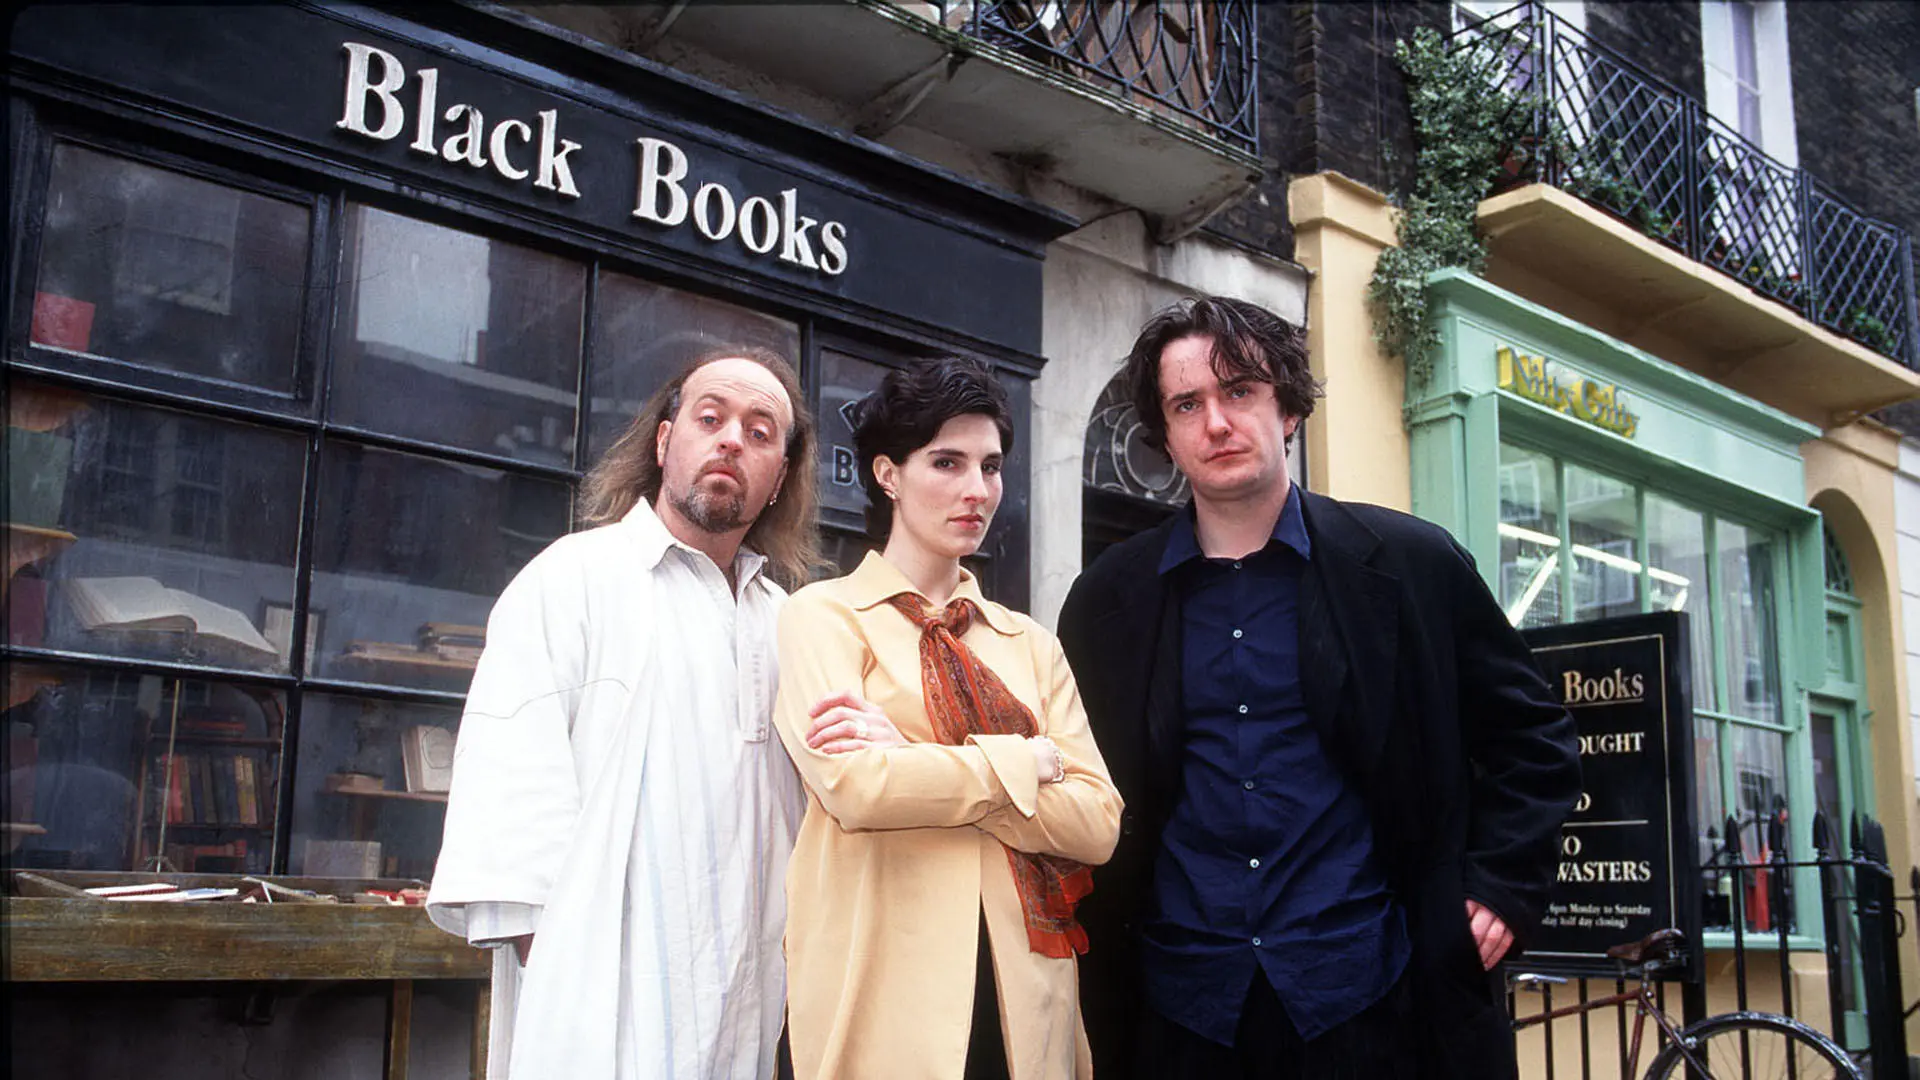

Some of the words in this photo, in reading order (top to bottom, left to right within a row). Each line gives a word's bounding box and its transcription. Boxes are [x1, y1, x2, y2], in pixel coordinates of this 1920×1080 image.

[336, 41, 583, 199] Black
[631, 136, 848, 276] Books
[1562, 667, 1644, 702] Books
[1577, 732, 1645, 755] OUGHT
[1569, 902, 1601, 915] Monday
[1603, 905, 1613, 914] to
[1615, 903, 1651, 916] Saturday
[1578, 916, 1593, 928] day
